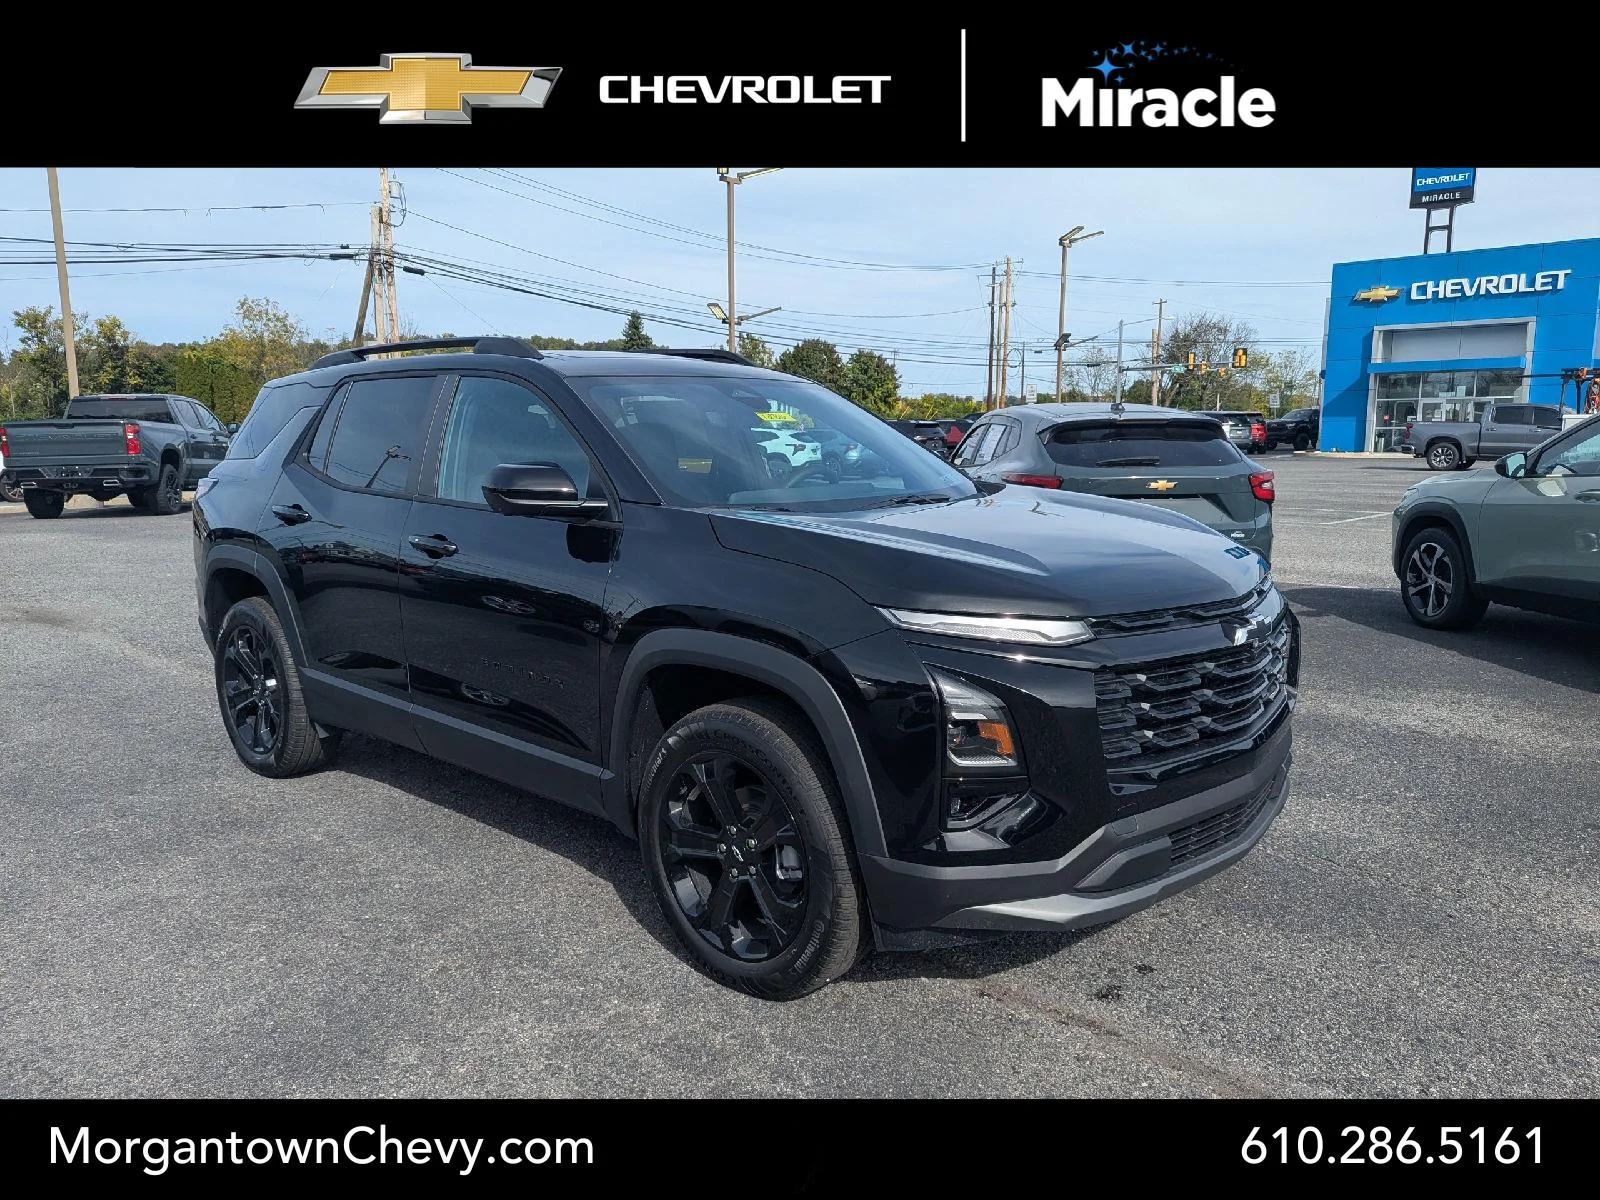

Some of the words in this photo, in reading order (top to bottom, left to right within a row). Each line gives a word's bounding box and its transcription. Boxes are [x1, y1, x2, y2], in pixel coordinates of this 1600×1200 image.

[1416, 172, 1471, 187] CHEVROLET
[1421, 191, 1461, 203] MIRACLE
[1410, 269, 1572, 301] CHEVROLET
